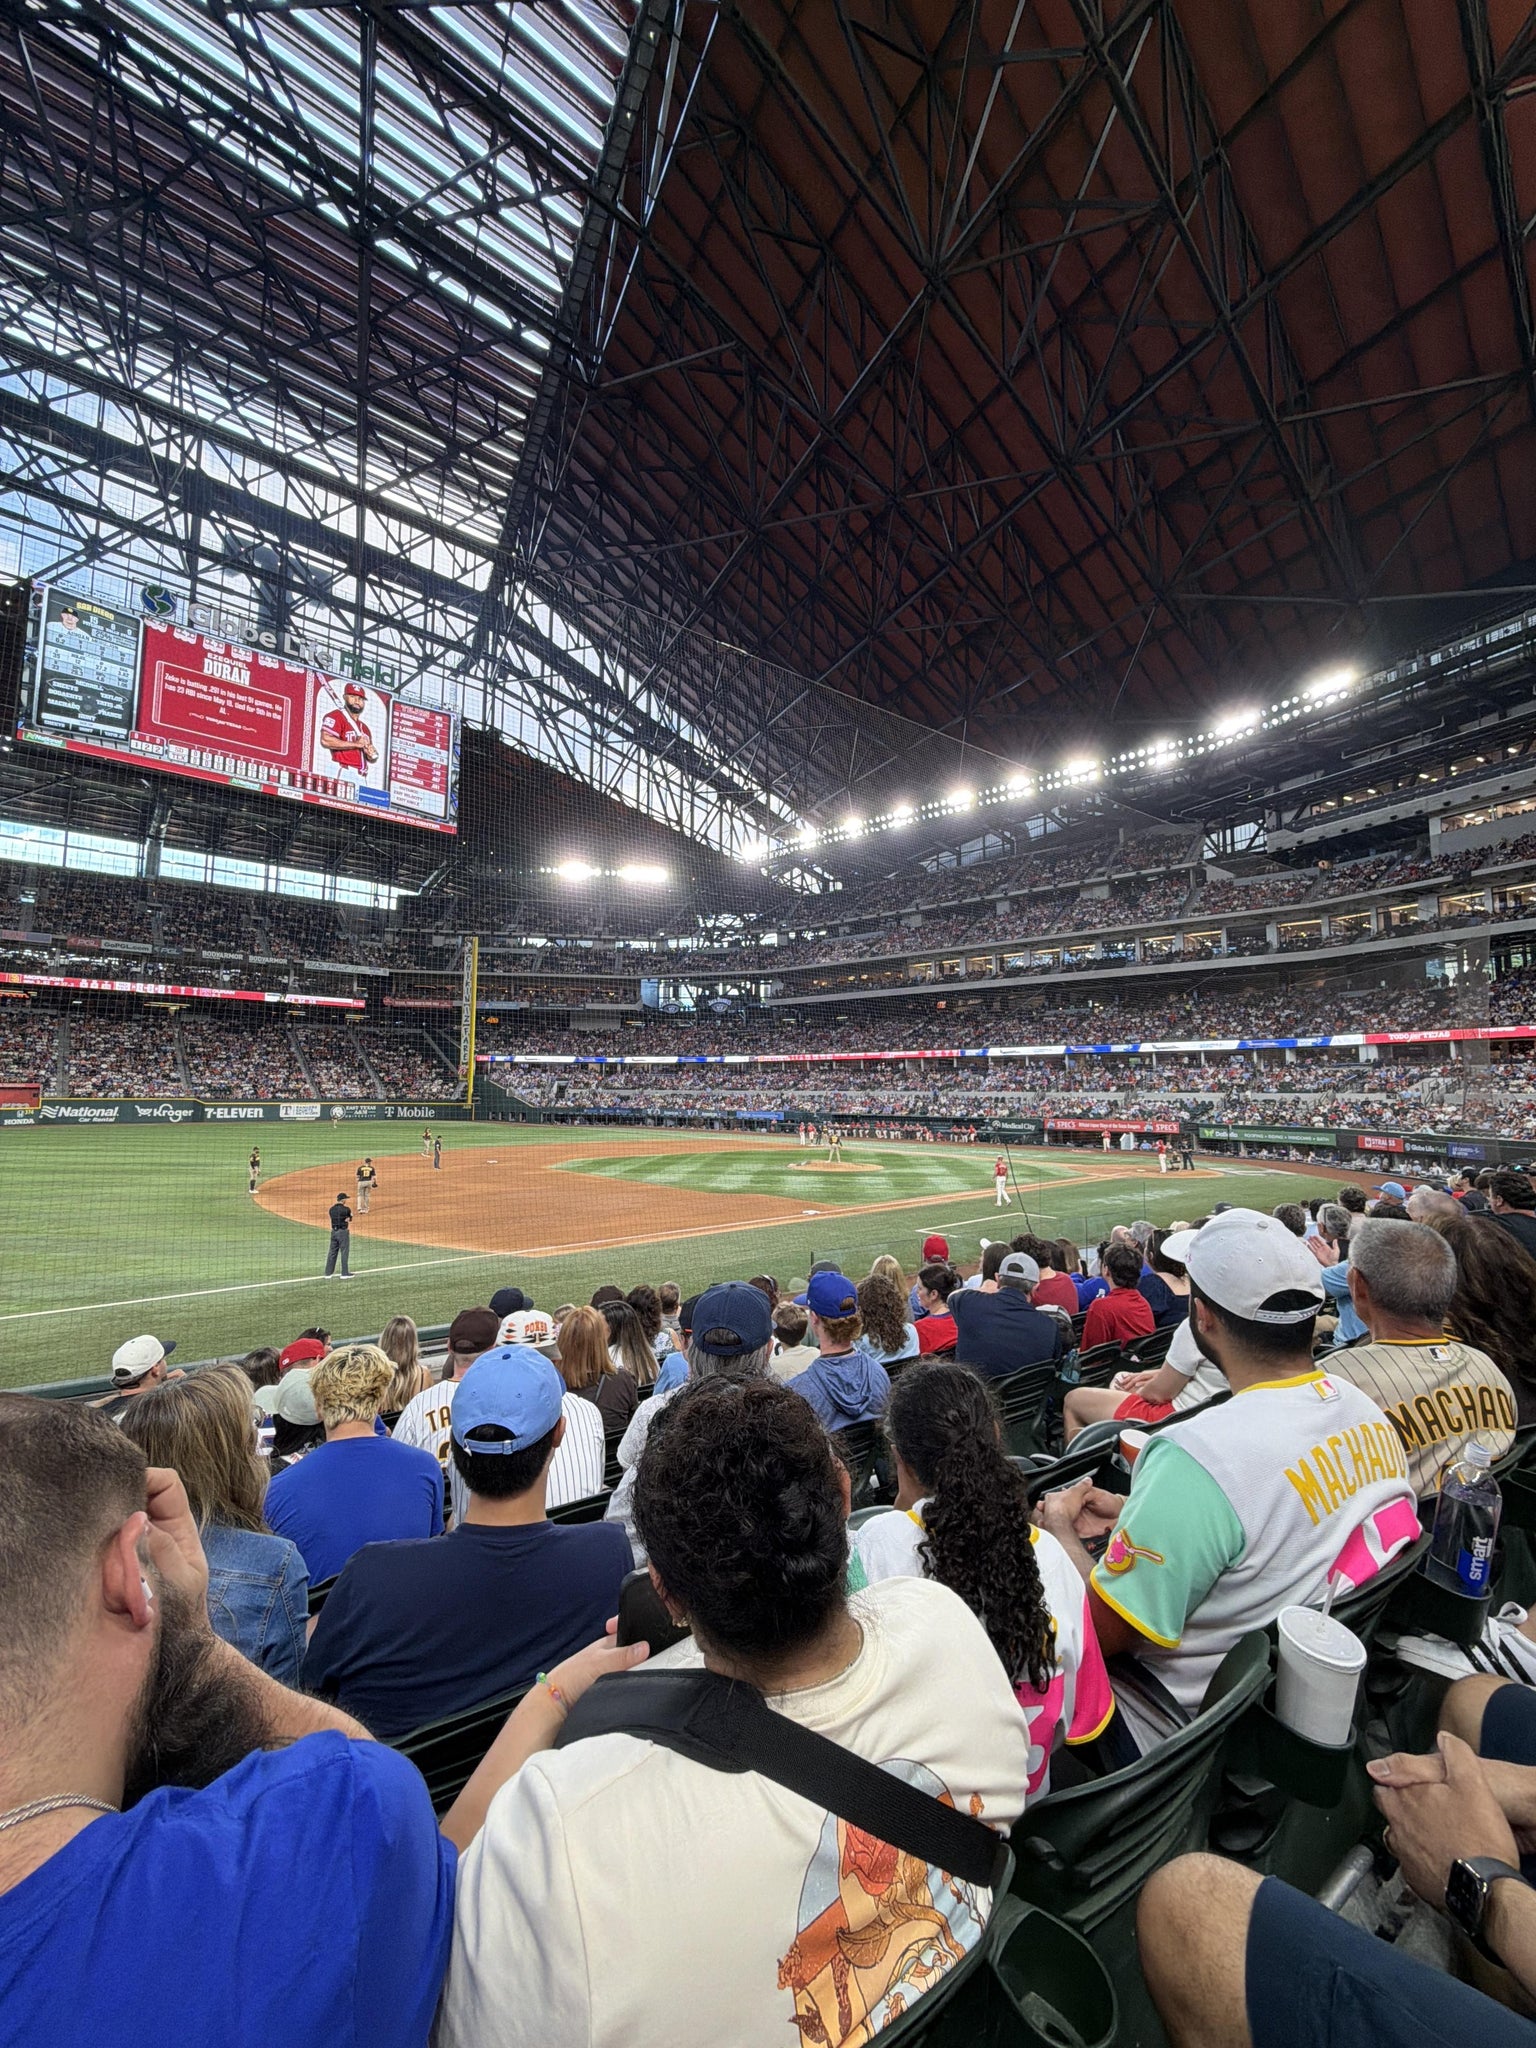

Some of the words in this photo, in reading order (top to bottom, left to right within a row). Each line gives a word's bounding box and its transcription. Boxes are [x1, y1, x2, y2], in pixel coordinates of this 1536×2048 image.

[188, 603, 277, 649] Globe
[284, 632, 333, 667] Life
[340, 650, 395, 688] Field
[207, 653, 249, 670] EZEQUIEL
[203, 658, 251, 685] DURAN
[319, 798, 355, 811] BRANDON
[202, 951, 244, 960] BODYARMOR
[248, 955, 288, 965] BODYARMOR
[57, 1105, 119, 1117] National
[153, 1103, 194, 1123] Kroger
[397, 1106, 435, 1117] Mobile
[1001, 1122, 1023, 1130] Medical
[1024, 1123, 1036, 1132] City
[1056, 1120, 1076, 1128] SPEC'S
[1155, 1123, 1178, 1132] SPEC'S
[1384, 1385, 1517, 1454] MACHAD
[1469, 1536, 1489, 1581] smart
